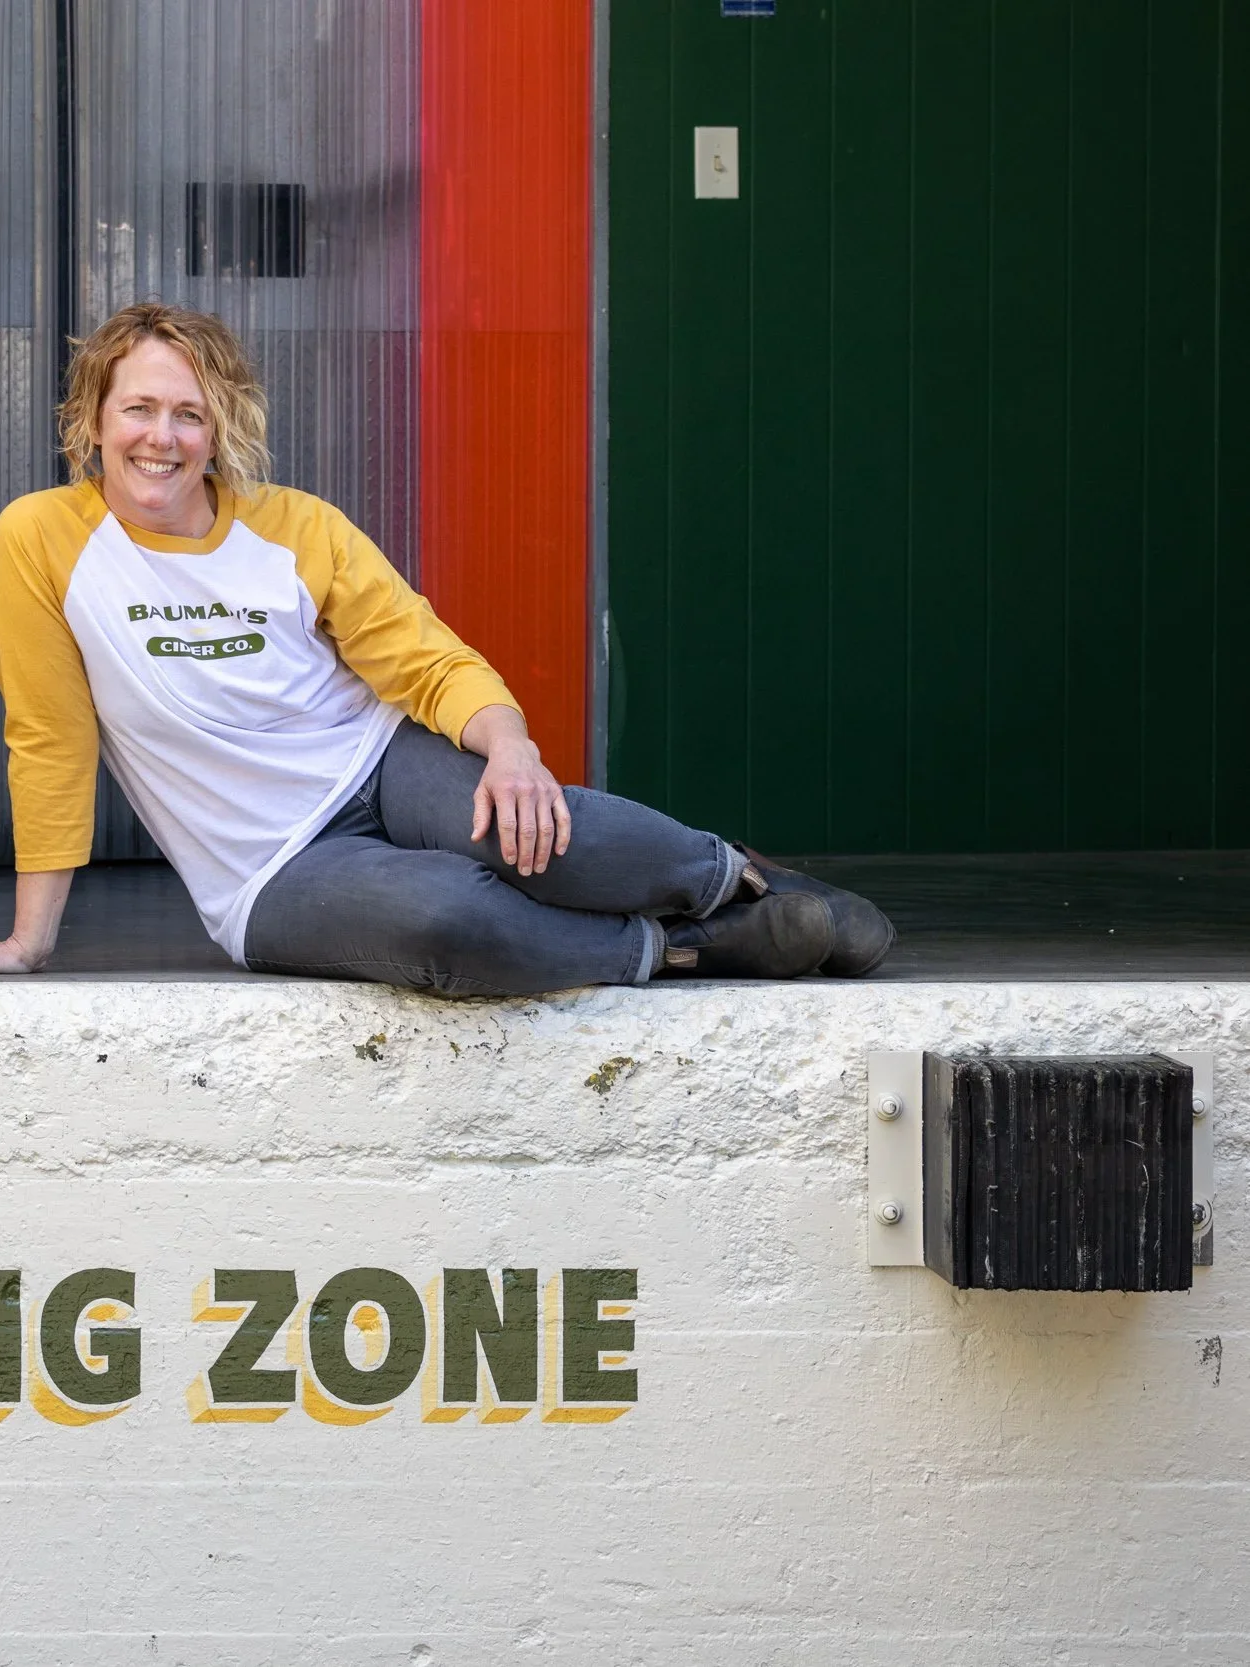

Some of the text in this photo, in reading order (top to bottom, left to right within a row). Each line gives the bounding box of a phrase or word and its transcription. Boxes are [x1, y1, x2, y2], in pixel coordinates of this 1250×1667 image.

[160, 639, 253, 656] CIDER CO.
[208, 1267, 639, 1405] ZONE
